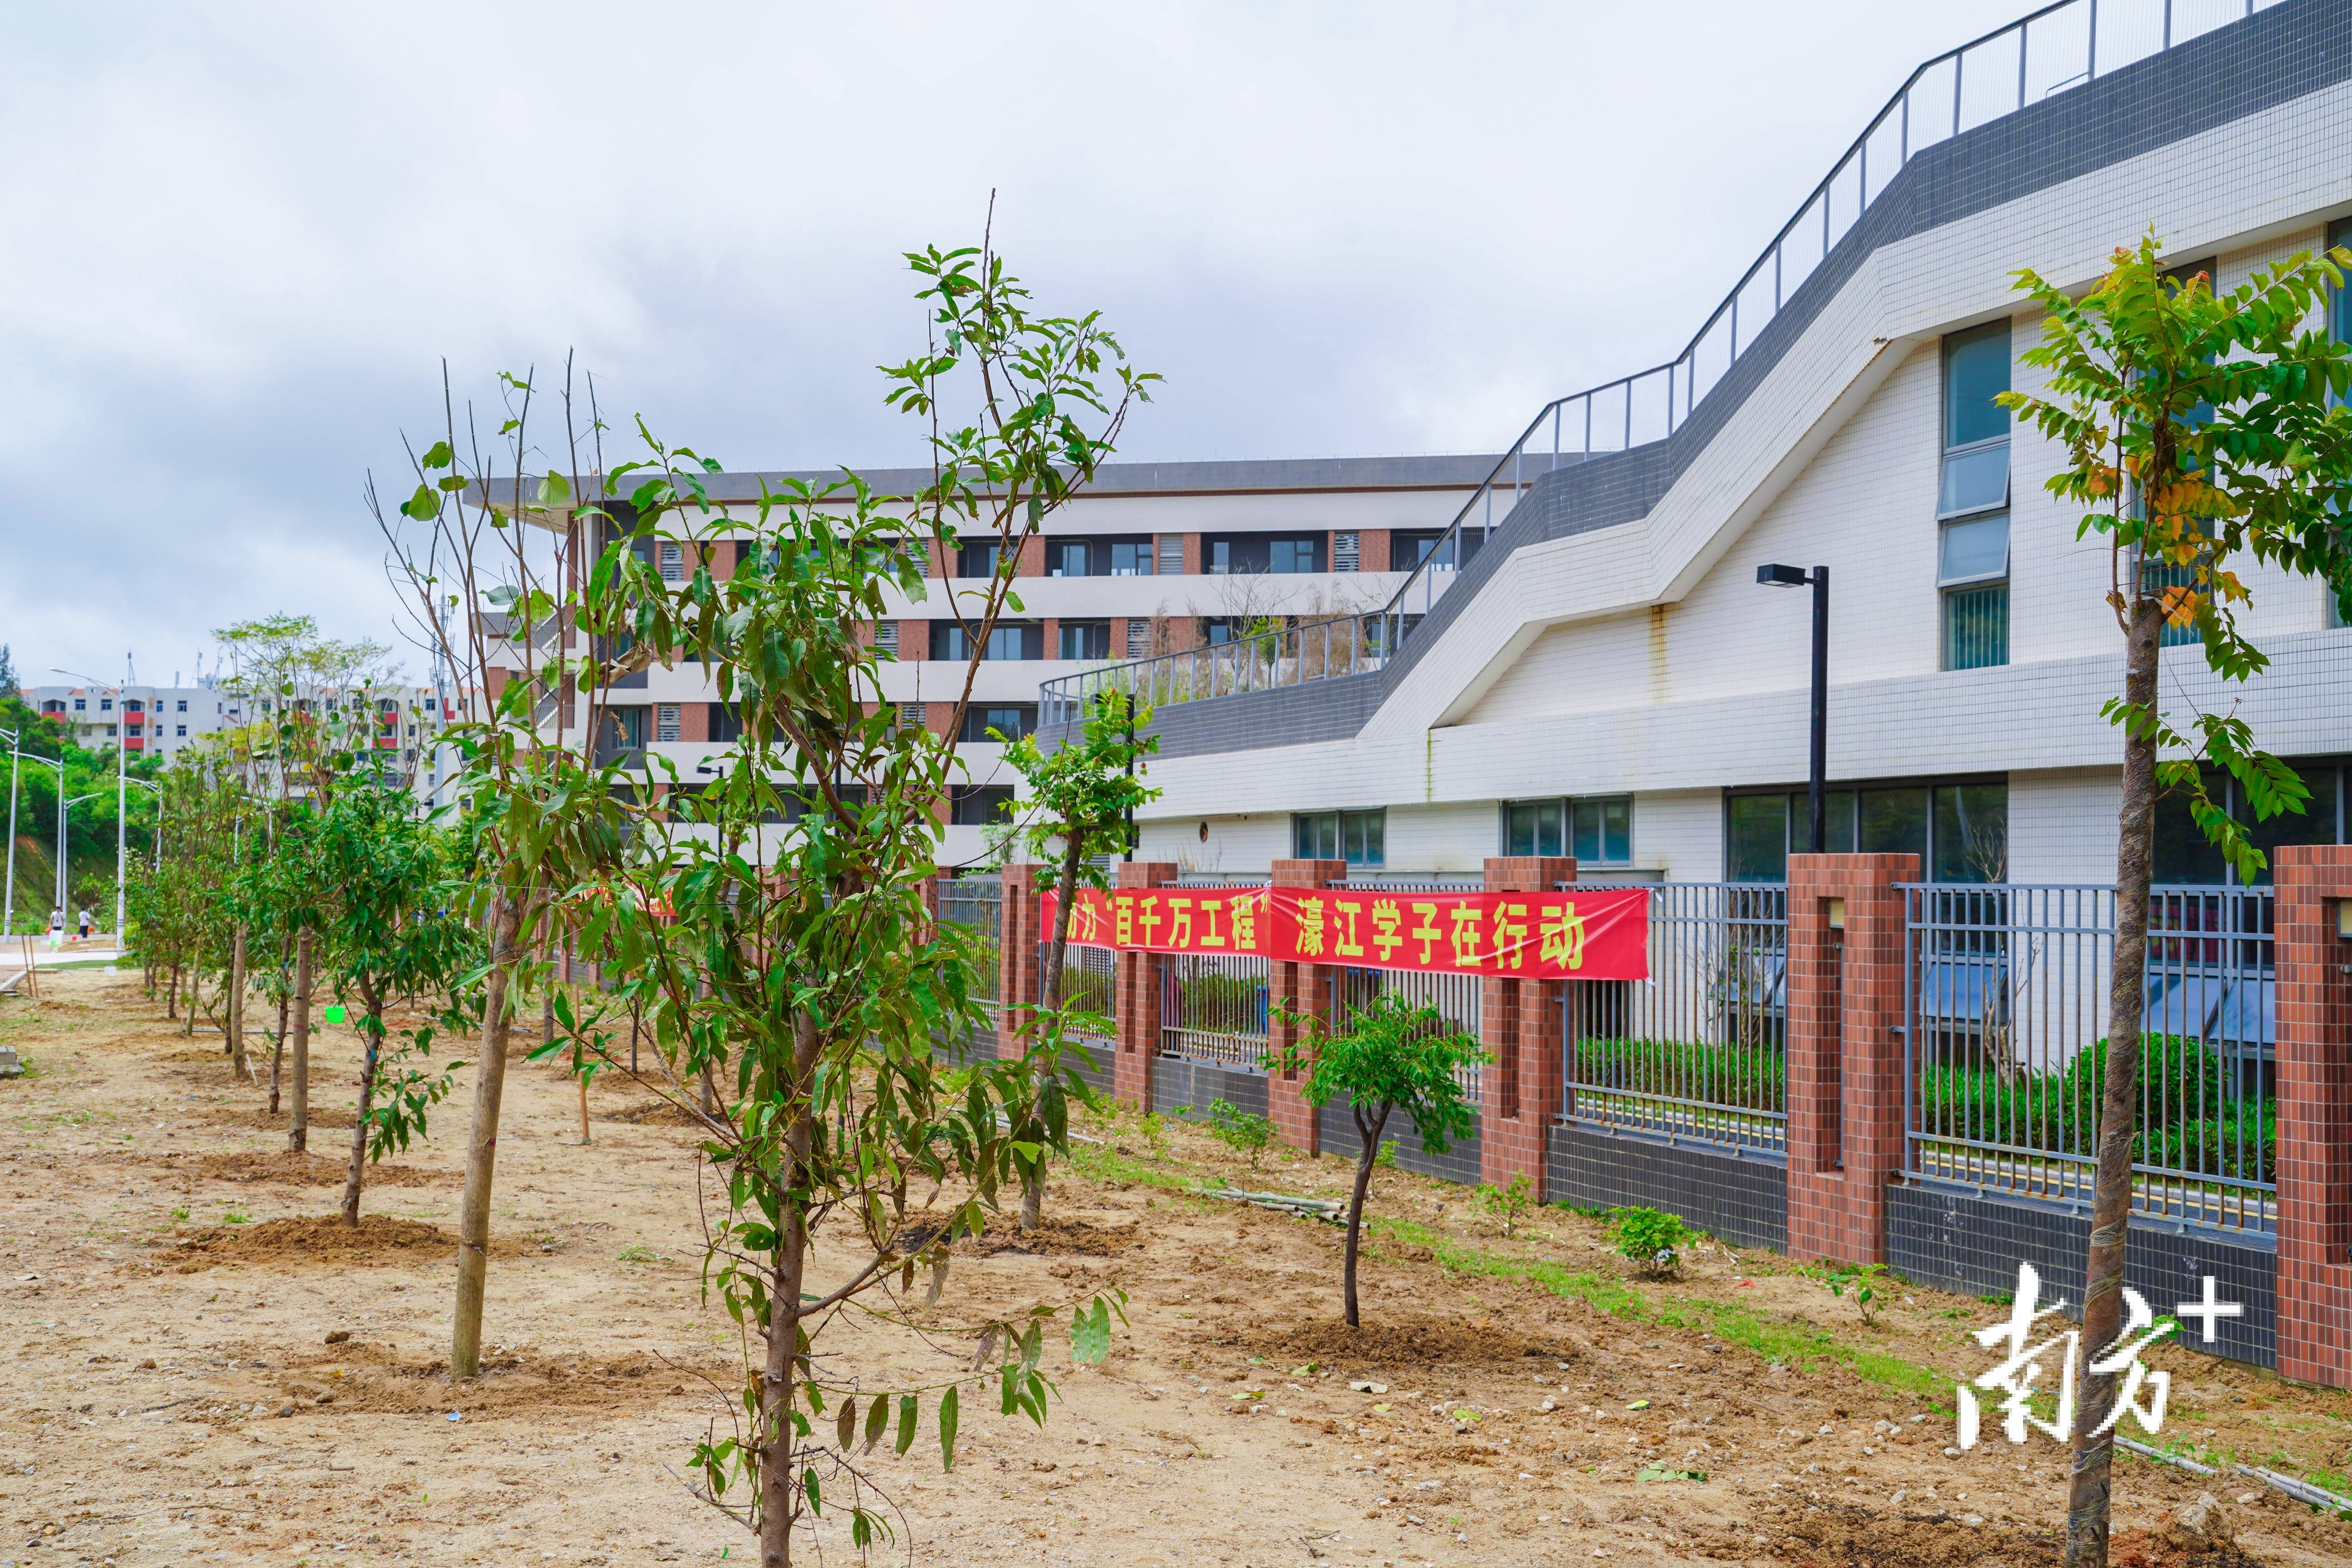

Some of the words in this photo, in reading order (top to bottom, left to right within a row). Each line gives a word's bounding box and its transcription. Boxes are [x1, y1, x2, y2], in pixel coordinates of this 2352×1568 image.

[1295, 897, 1586, 970] 濠江学子在行动
